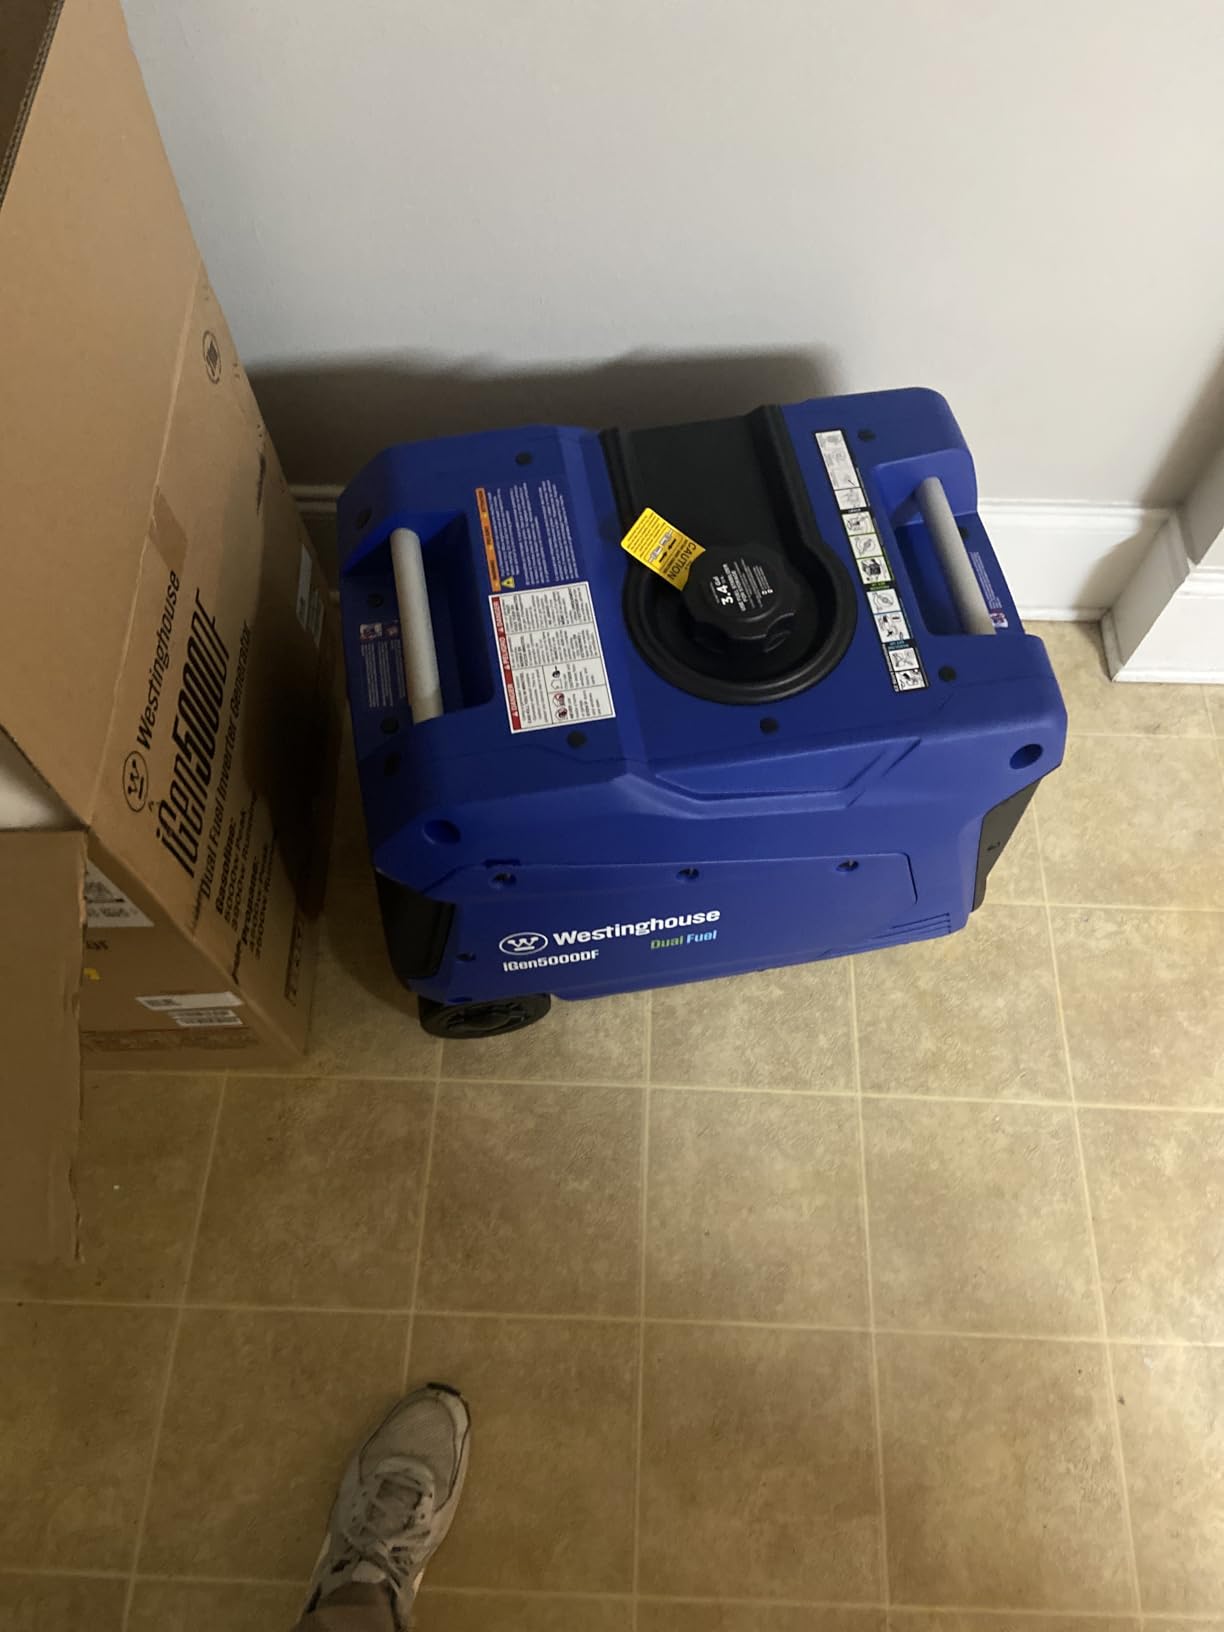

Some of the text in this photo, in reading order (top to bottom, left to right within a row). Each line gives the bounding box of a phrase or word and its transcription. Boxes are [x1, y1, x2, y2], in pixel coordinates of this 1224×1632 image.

[667, 542, 697, 580] CAUTION
[717, 584, 734, 606] 3.4
[136, 570, 180, 751] Westinghouse
[156, 587, 230, 878] iGen5000DF
[215, 715, 237, 801] Inverter
[209, 797, 224, 847] Fuel
[200, 845, 216, 900] Dual
[553, 909, 721, 946] Westinghouse
[651, 930, 717, 949] Dual Fuel
